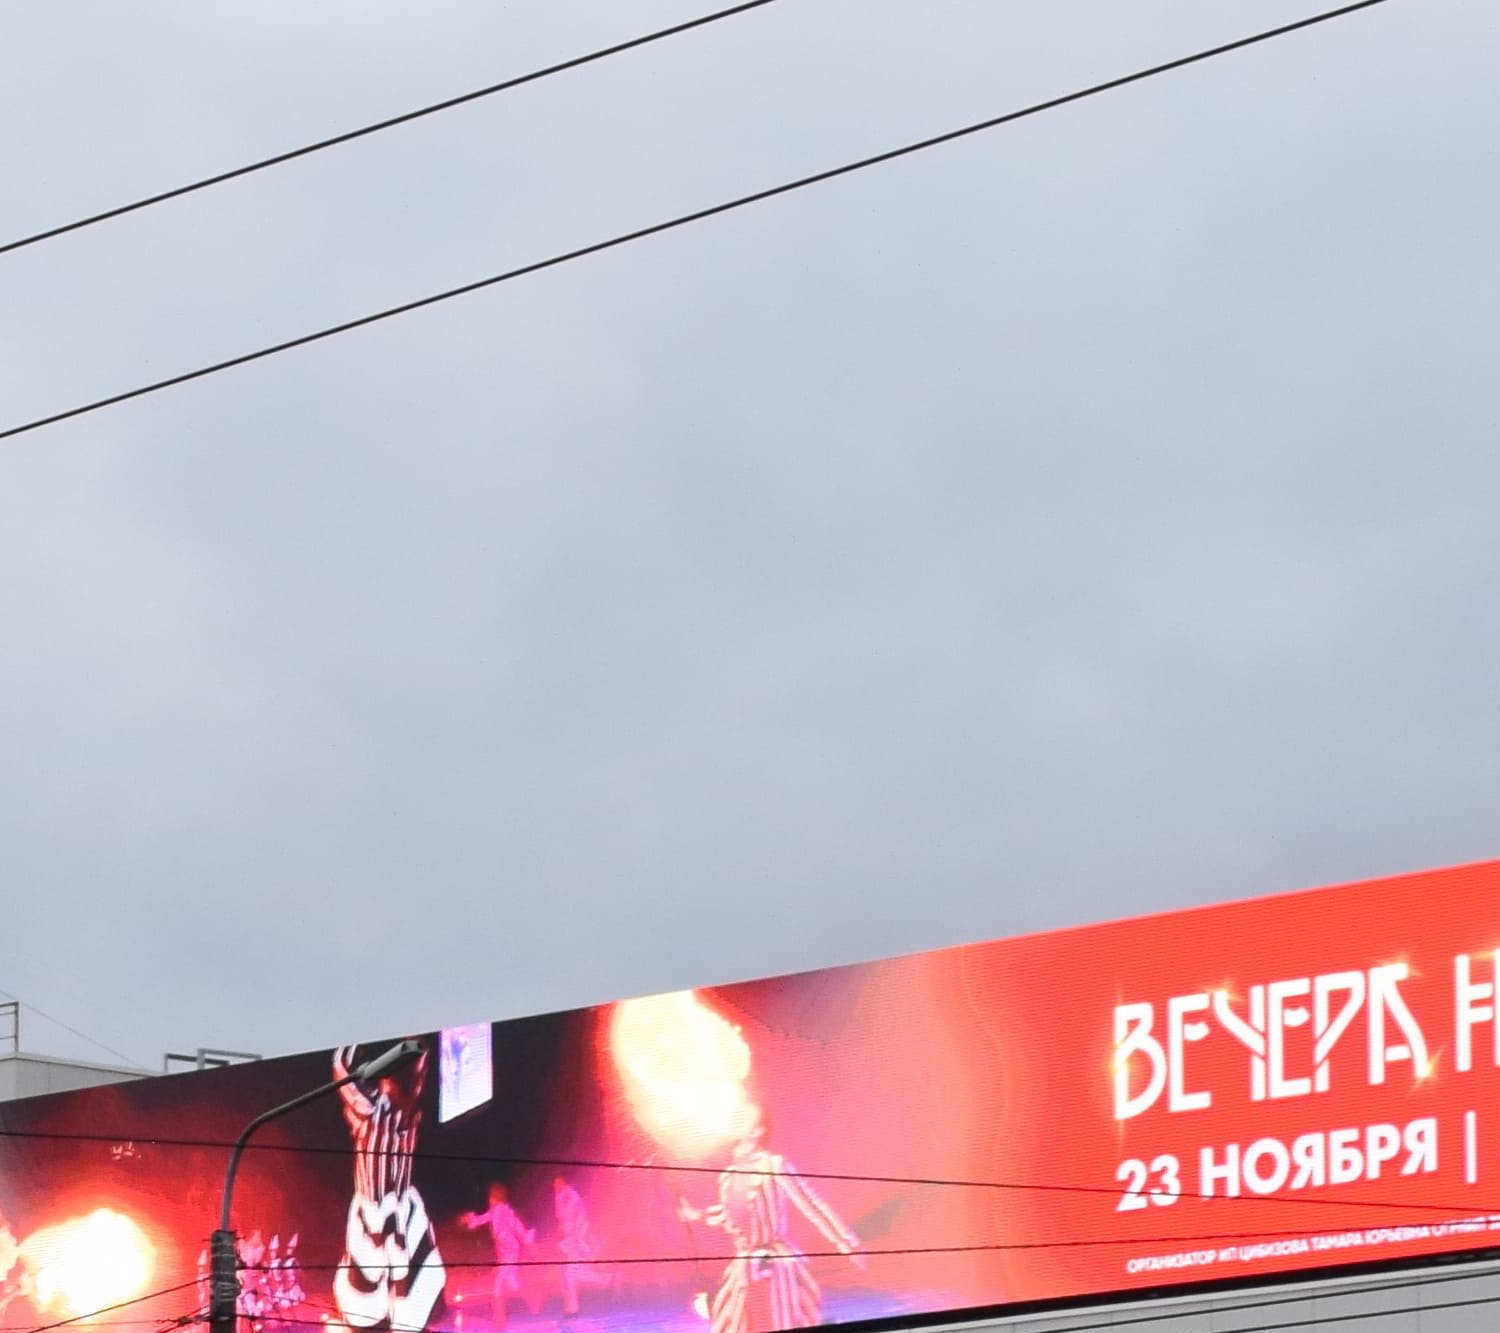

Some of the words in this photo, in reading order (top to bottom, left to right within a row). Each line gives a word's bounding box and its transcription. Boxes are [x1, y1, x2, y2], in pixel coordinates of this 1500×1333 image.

[1113, 960, 1433, 1120] ВЕЧЕРА
[1116, 1154, 1182, 1213] 23
[1200, 1116, 1438, 1202] НОЯБРЯ
[1127, 1248, 1216, 1274] ОРГАНИЗАТОР
[1311, 1231, 1364, 1252] ТАМАРА
[1365, 1224, 1429, 1246] ЮРЬЕВНА
